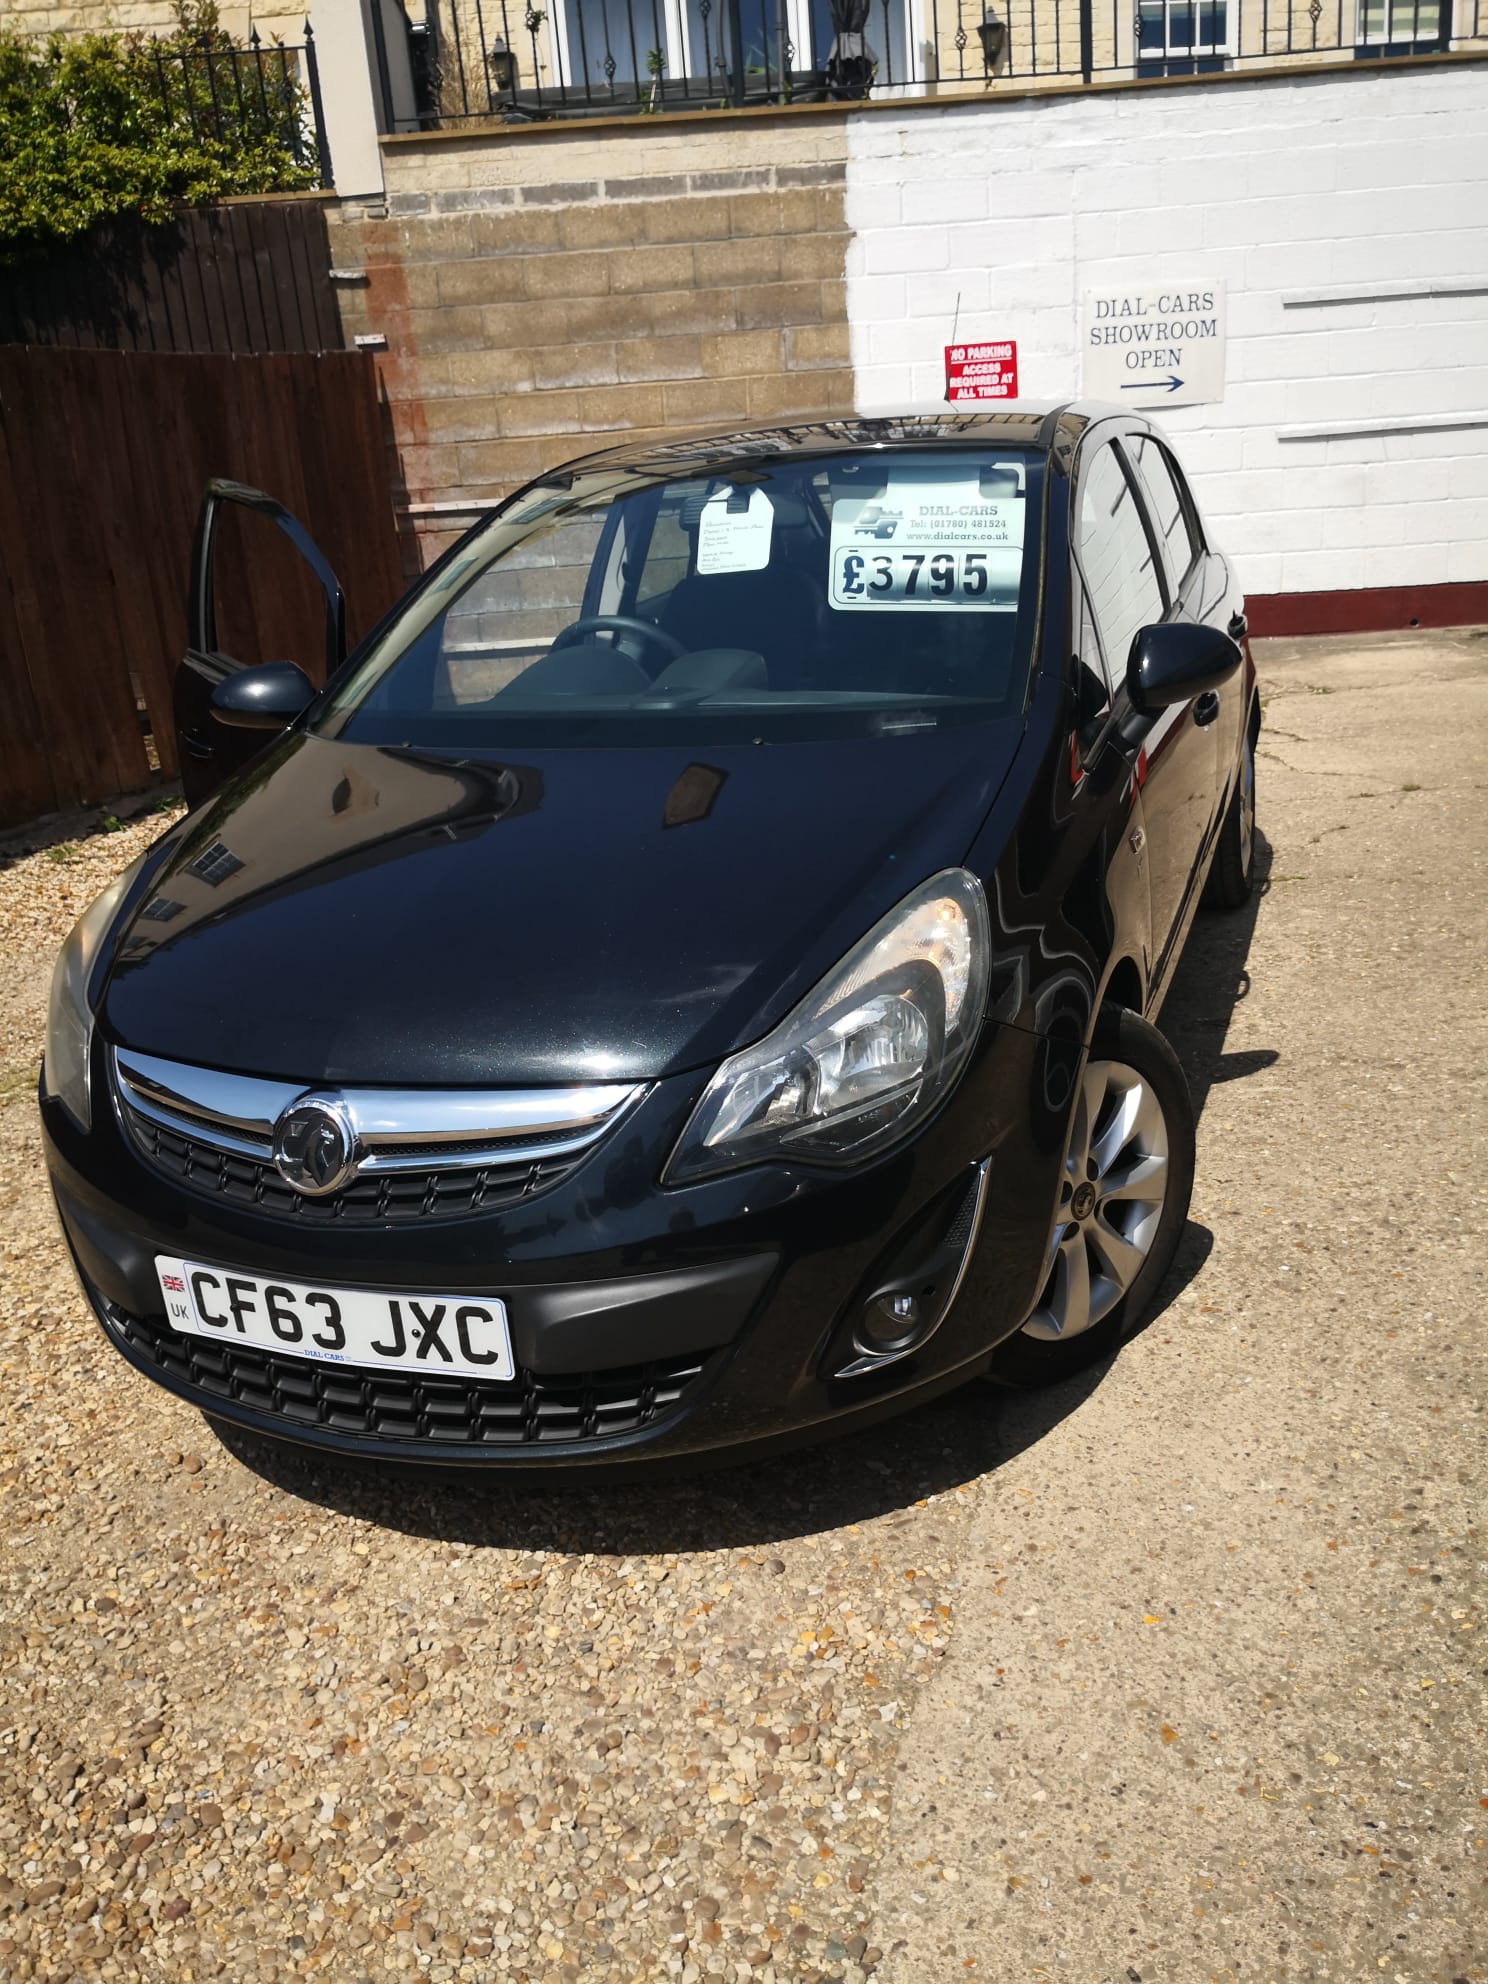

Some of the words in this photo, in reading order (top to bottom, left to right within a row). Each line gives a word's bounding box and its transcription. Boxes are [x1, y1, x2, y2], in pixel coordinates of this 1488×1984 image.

[1095, 292, 1214, 318] DIAL-CARS
[1090, 319, 1218, 345] SHOWROOM
[950, 348, 965, 360] NO
[967, 344, 1012, 359] PARKING
[1125, 348, 1183, 369] OPEN
[962, 362, 1001, 375] ACCESS
[949, 374, 999, 388] REQUIRED
[1001, 372, 1014, 384] AT
[957, 387, 976, 399] ALL
[977, 384, 1008, 397] TIMES
[919, 505, 998, 516] DIAL-CARS
[910, 520, 926, 529] Tel:
[930, 519, 968, 529] (01780)
[970, 519, 1006, 528] 481524
[906, 532, 1008, 541] www.dialcars.co.uk
[842, 554, 988, 597] £3795
[170, 1302, 189, 1320] UK
[190, 1271, 346, 1350] CF63
[370, 1300, 498, 1365] JXC
[304, 1349, 323, 1358] DIAL
[324, 1353, 345, 1361] CARS
